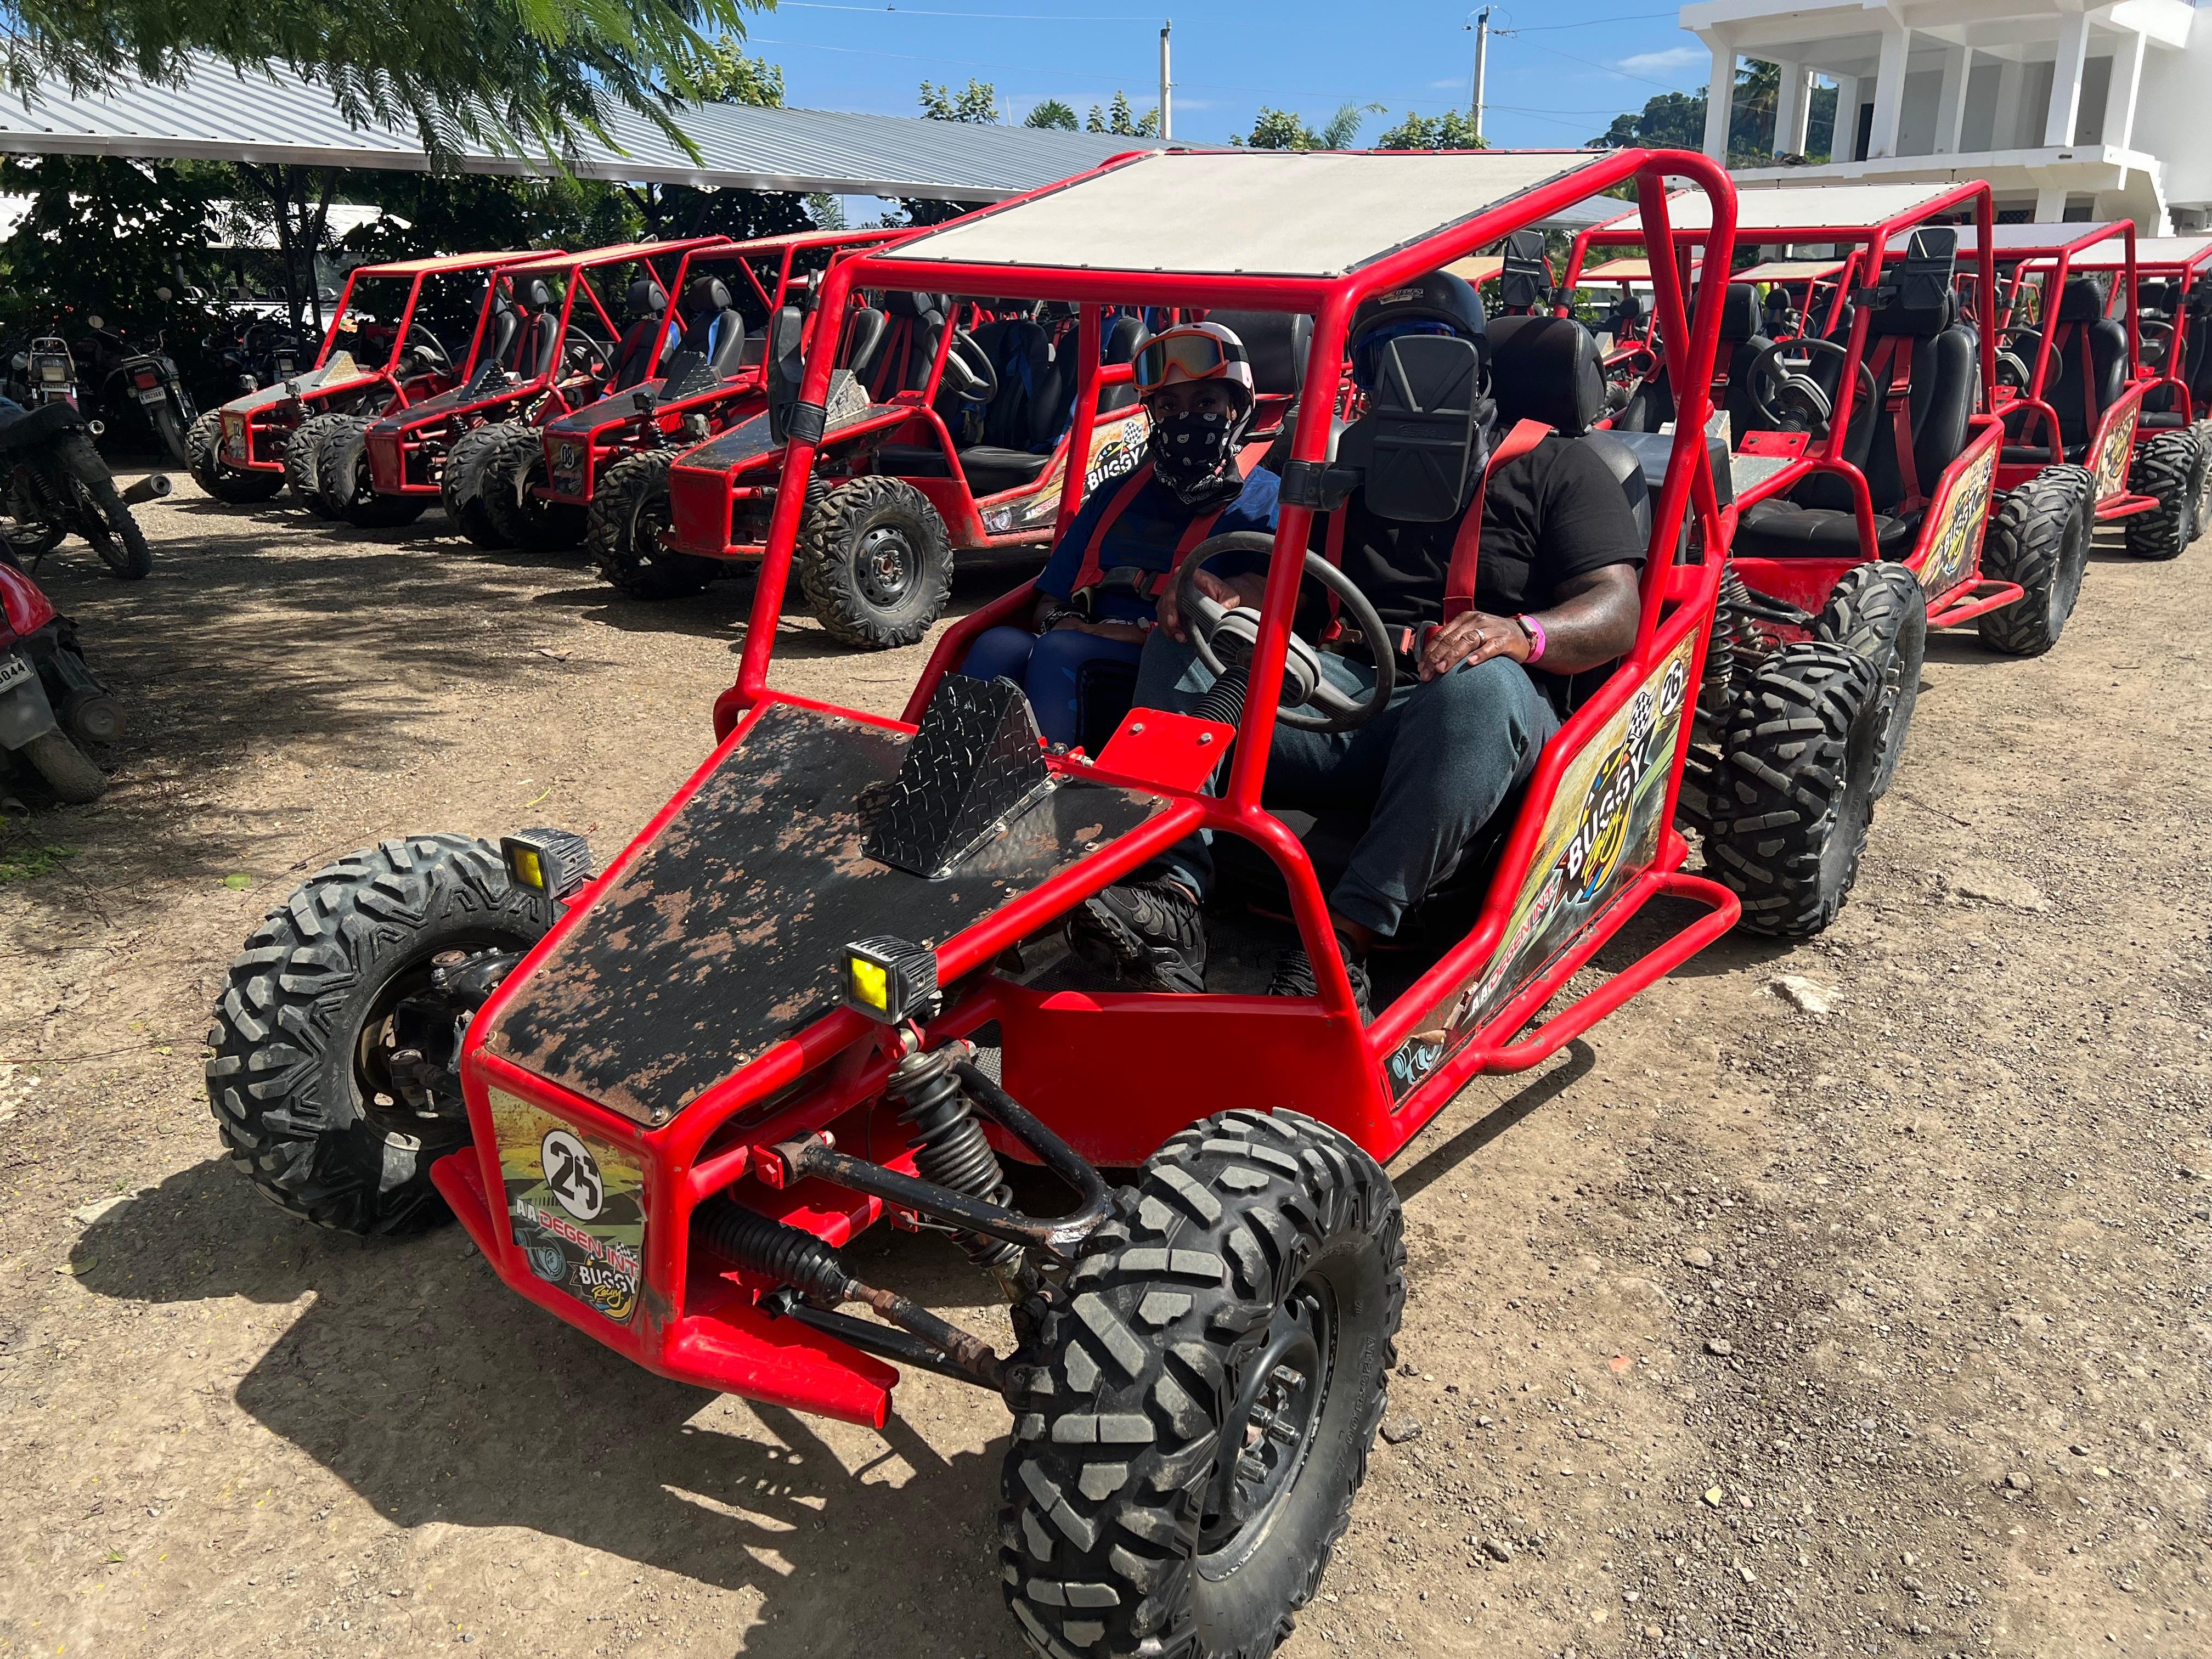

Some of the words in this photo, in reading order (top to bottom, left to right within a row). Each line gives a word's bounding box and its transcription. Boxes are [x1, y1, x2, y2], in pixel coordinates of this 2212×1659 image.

[1087, 447, 1140, 491] BUGGY
[1661, 662, 1681, 713] 26
[1568, 742, 1645, 881] BUGGY
[1471, 983, 1489, 1014] AA
[1489, 916, 1531, 990] DEGEN
[516, 1198, 538, 1223] AA
[539, 1208, 603, 1259] DEGEN
[579, 1265, 636, 1295] BUGGY
